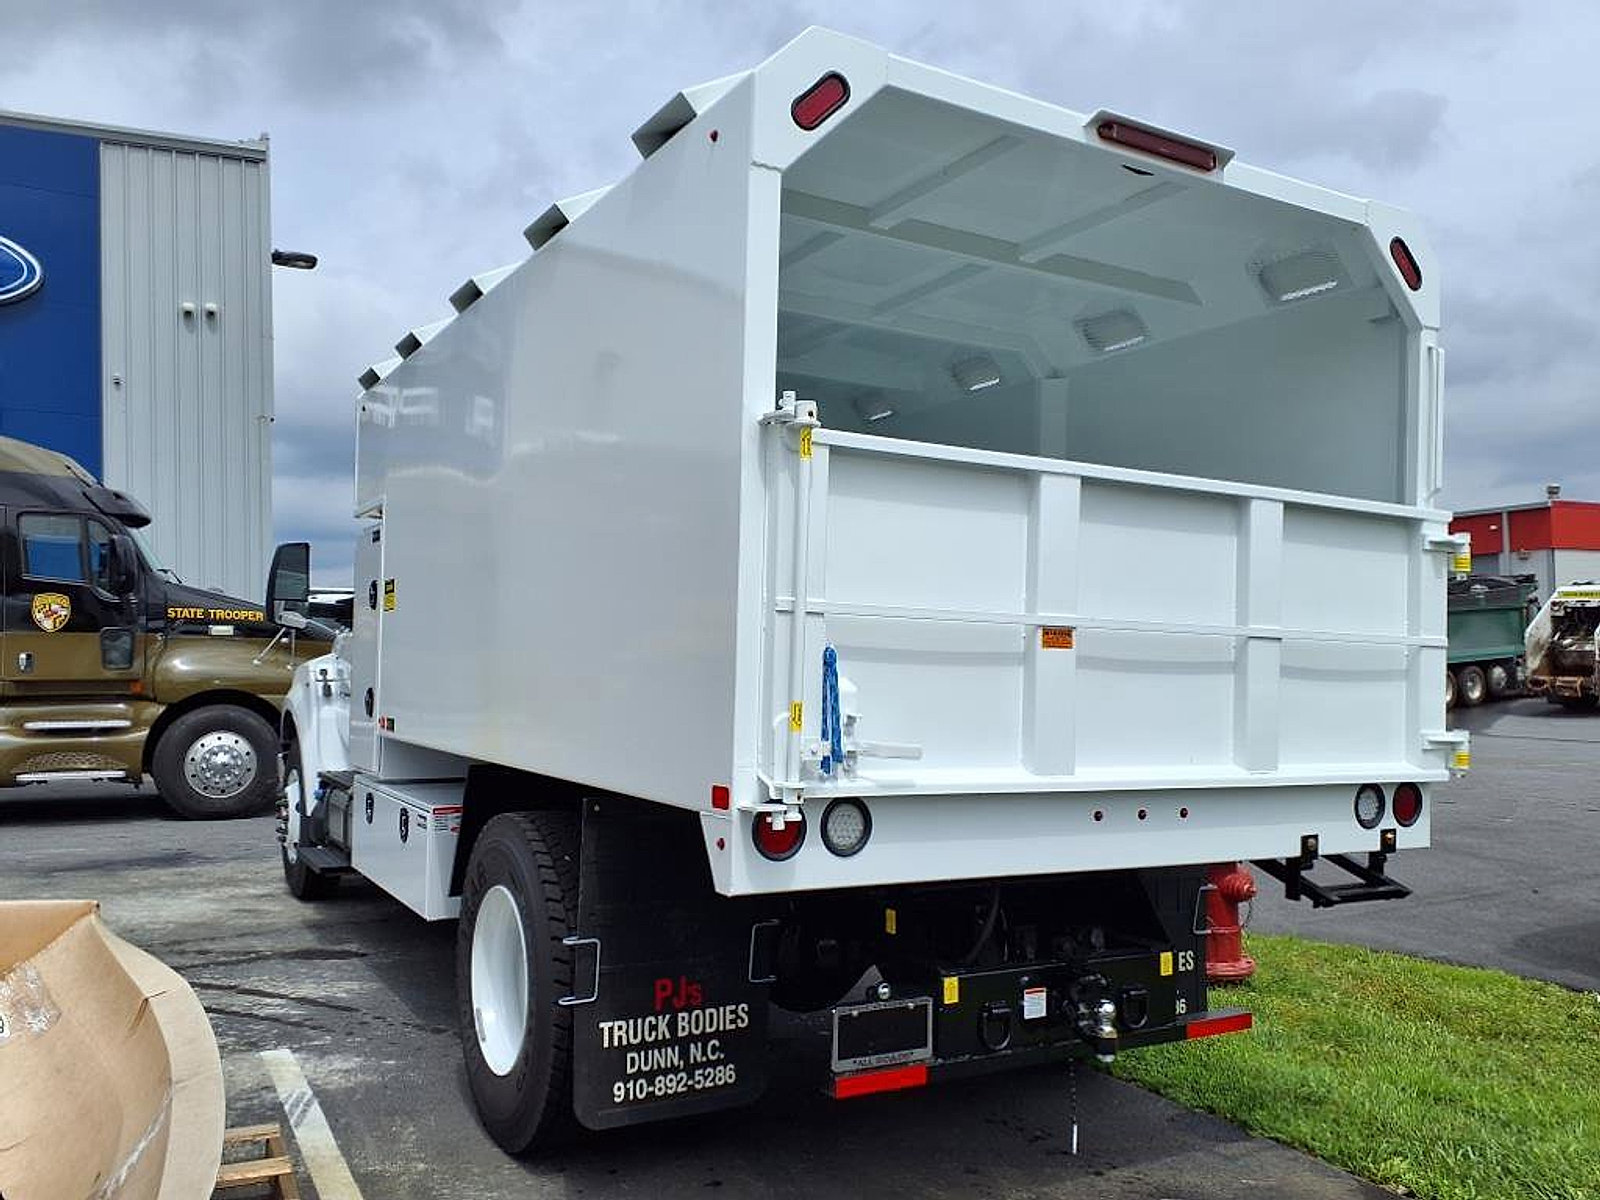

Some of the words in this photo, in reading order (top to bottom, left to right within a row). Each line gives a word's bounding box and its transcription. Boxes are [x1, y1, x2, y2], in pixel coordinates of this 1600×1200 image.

[167, 607, 205, 619] STATE
[207, 609, 264, 622] TROOPER
[653, 975, 703, 1012] PJs
[599, 1013, 672, 1049] TRUCK
[677, 1002, 750, 1038] BODIES
[626, 1044, 685, 1075] DUNN,
[690, 1039, 725, 1065] N.C.
[613, 1063, 736, 1104] 910-892-5286
